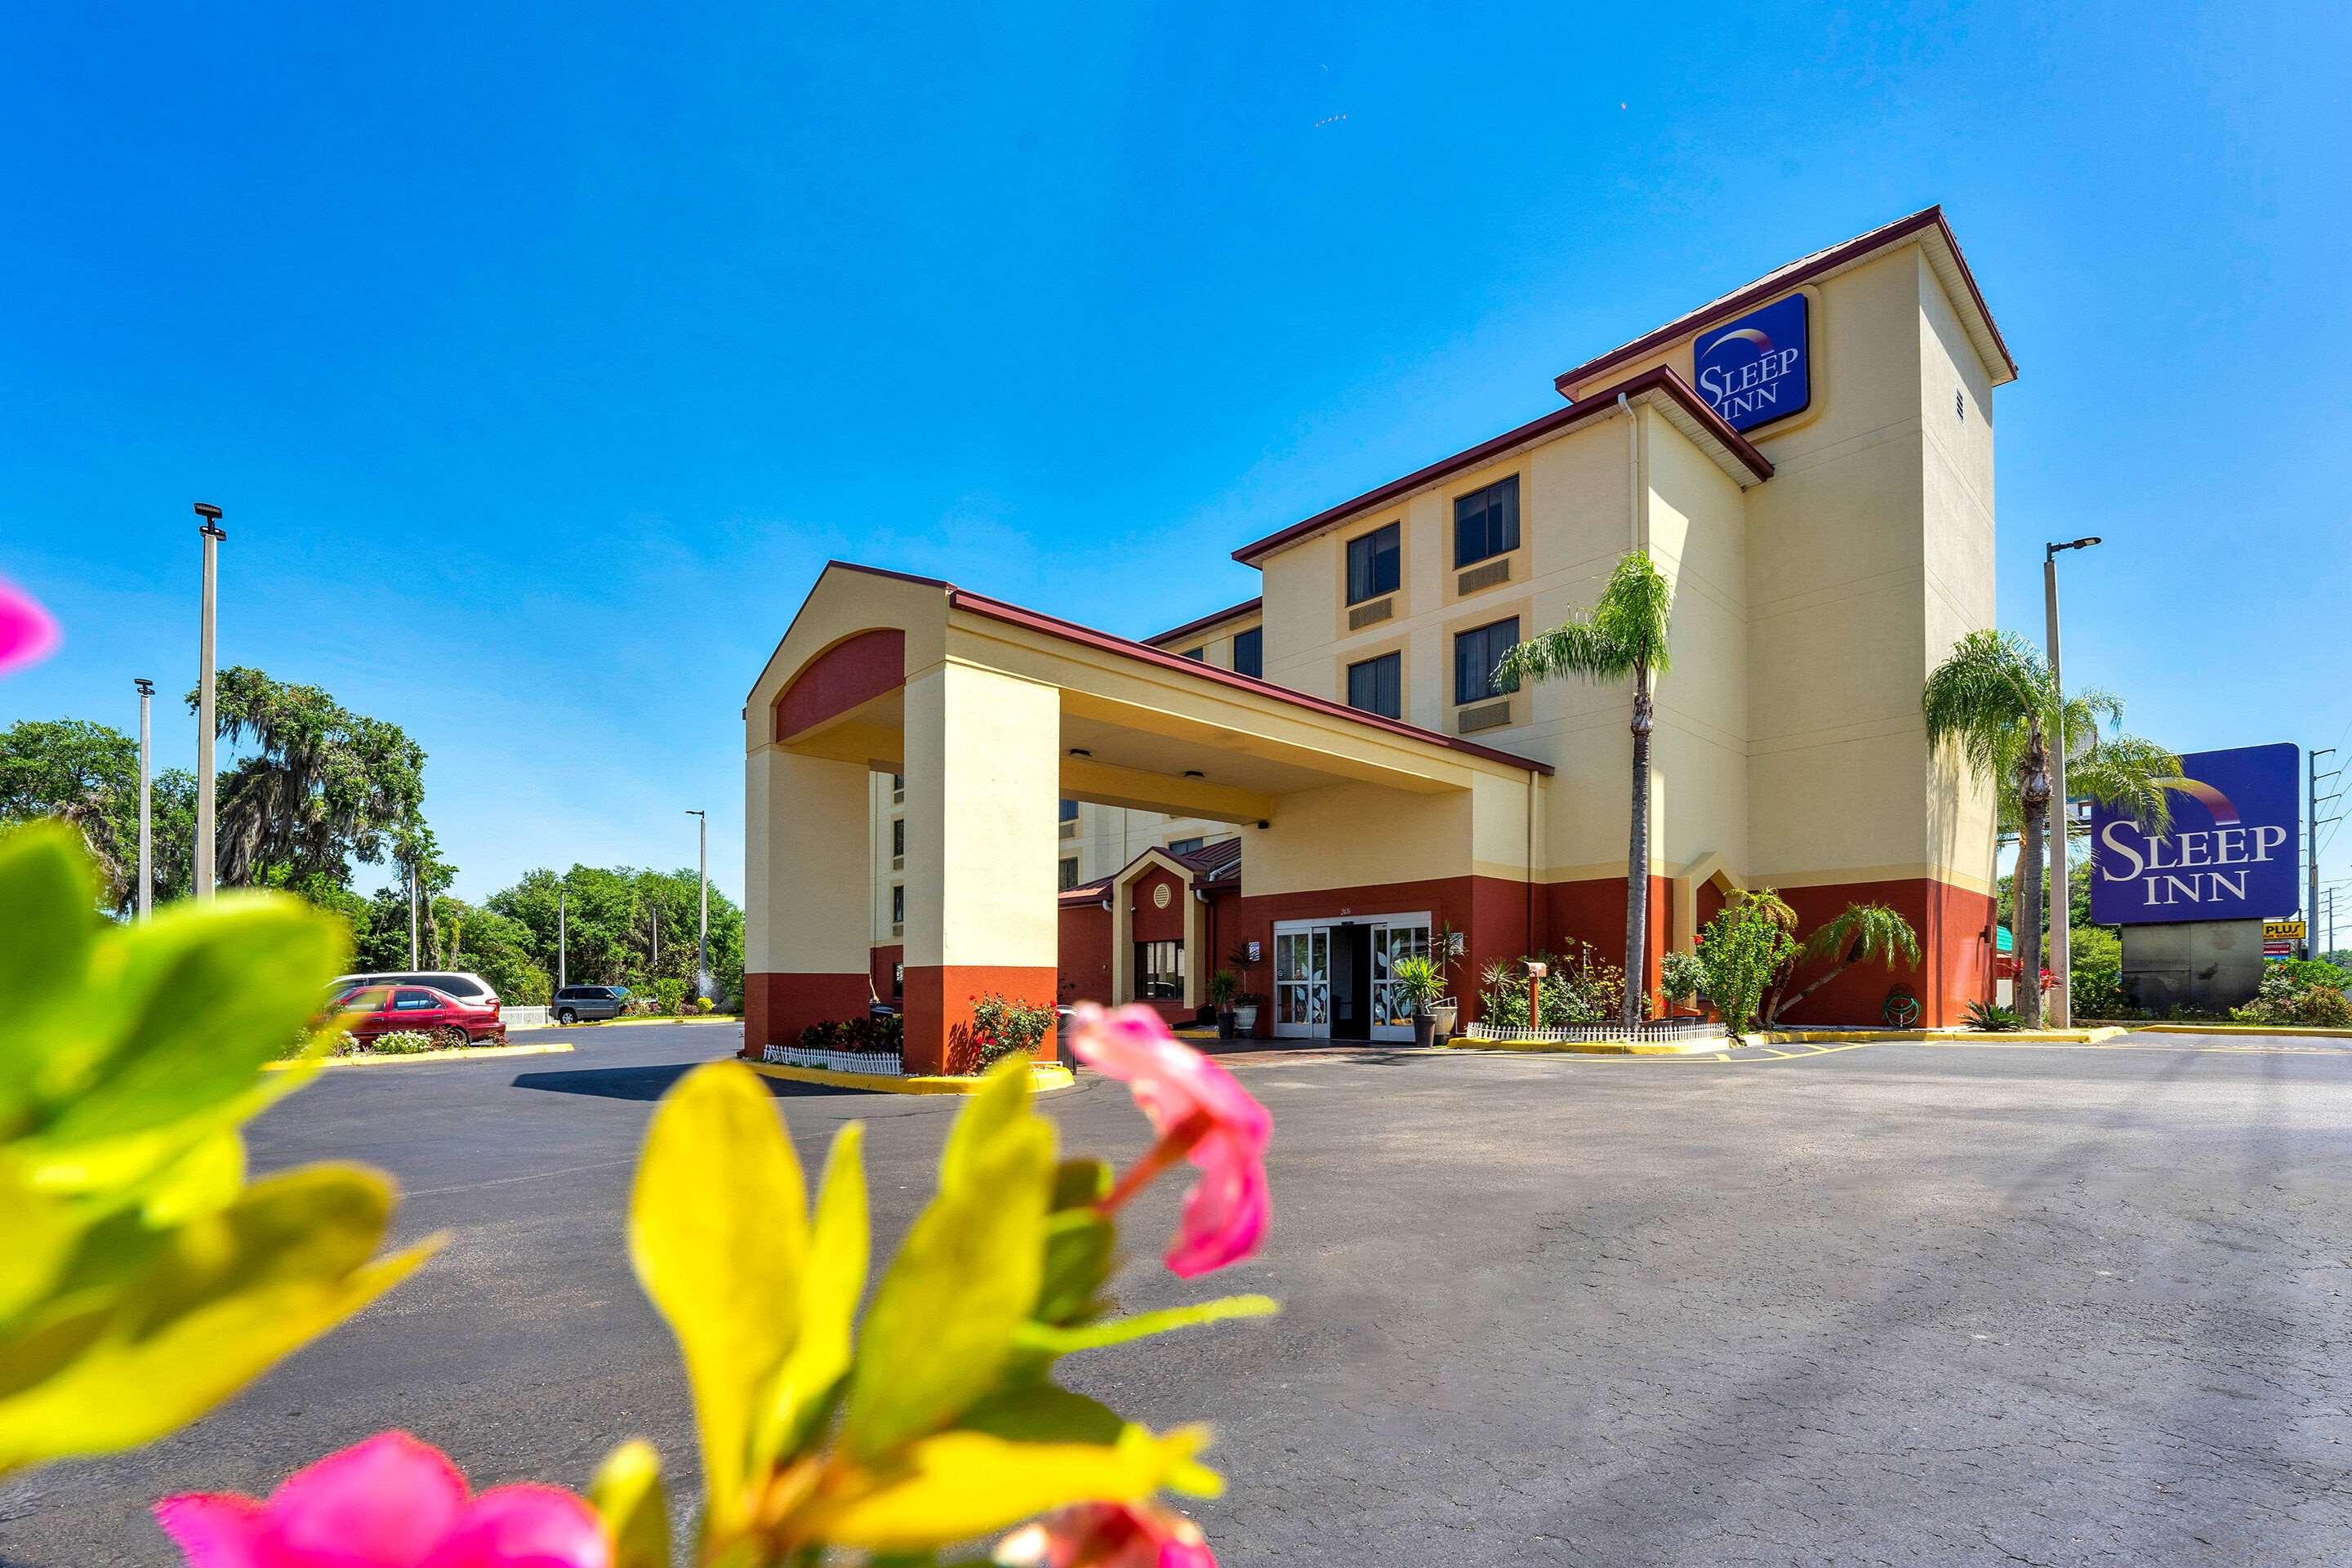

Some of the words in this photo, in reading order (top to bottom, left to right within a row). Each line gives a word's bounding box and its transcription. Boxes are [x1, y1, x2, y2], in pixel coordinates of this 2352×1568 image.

[1699, 348, 1798, 409] SLEEP
[1722, 382, 1779, 421] INN
[2101, 820, 2287, 882] SLEEP
[2142, 870, 2250, 906] INN
[2265, 924, 2301, 935] PLUS
